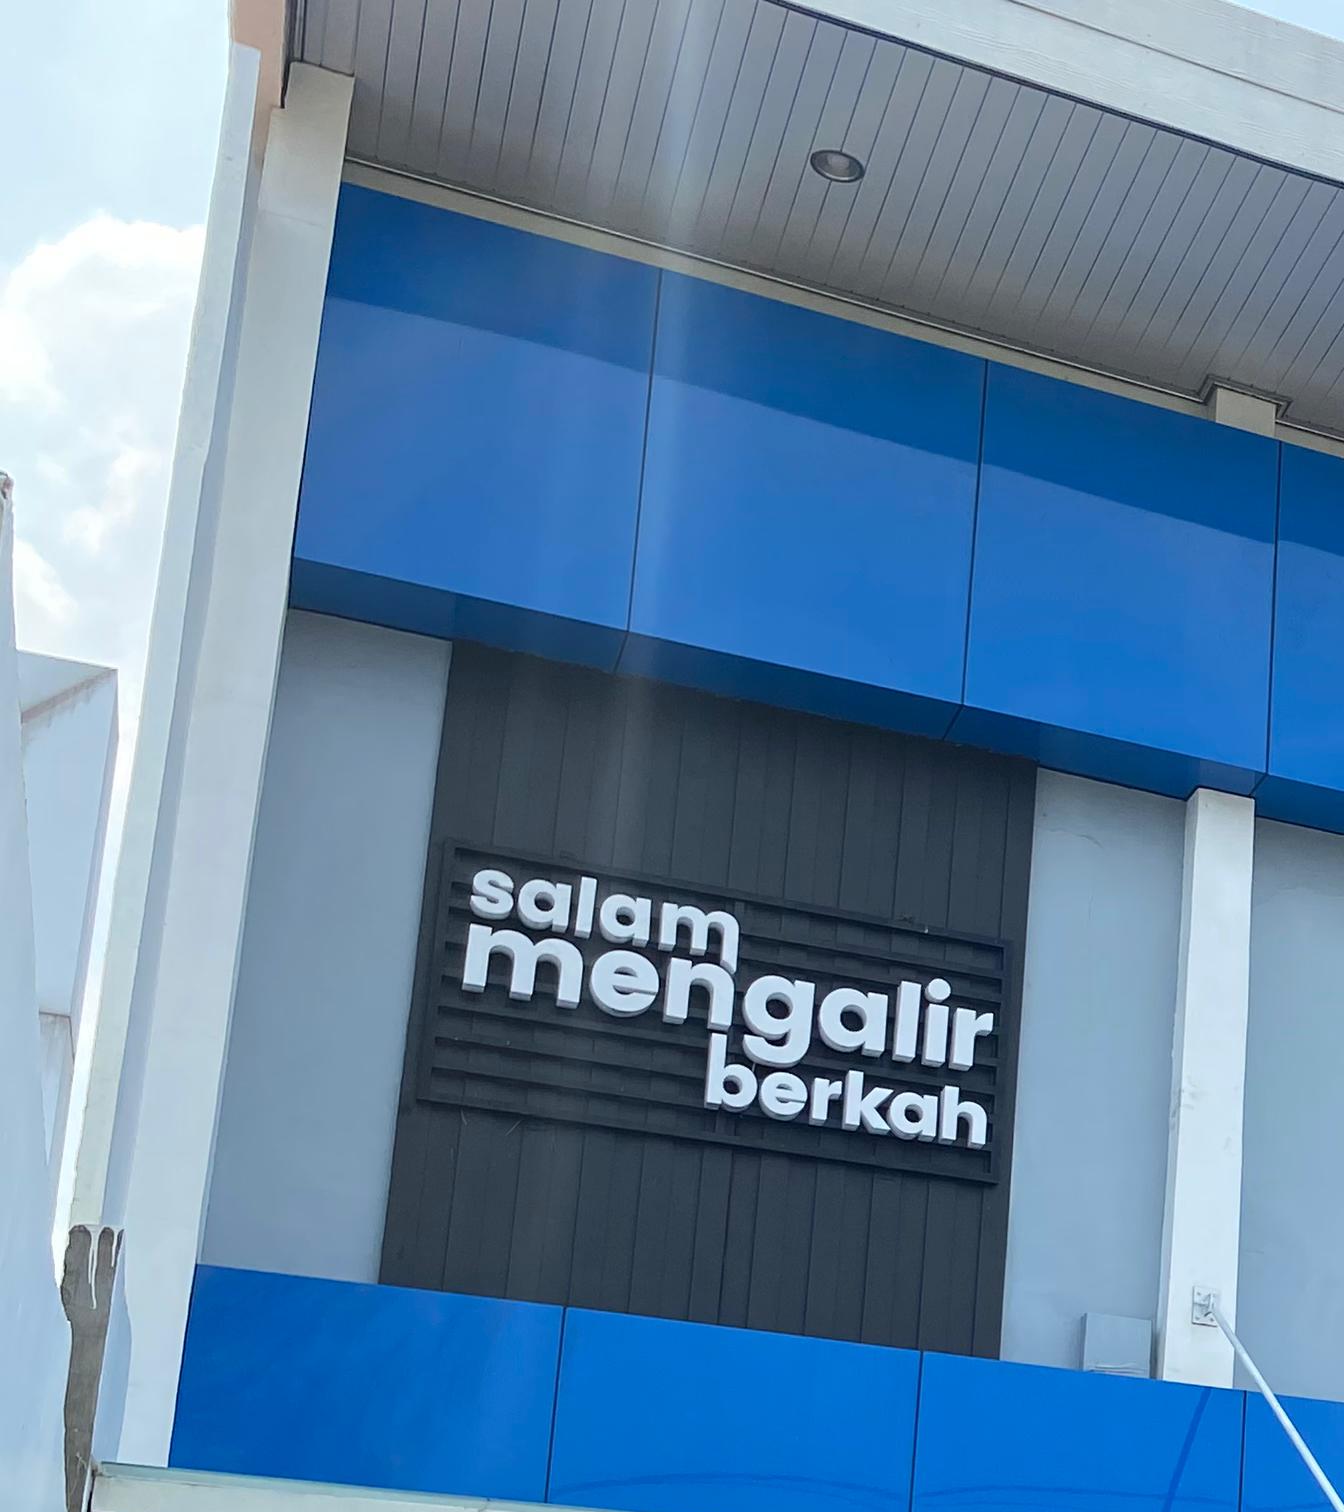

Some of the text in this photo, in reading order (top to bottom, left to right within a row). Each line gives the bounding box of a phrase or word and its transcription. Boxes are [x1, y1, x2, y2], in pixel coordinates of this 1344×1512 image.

[470, 869, 740, 975] salam
[461, 923, 993, 1071] mengalir
[705, 1032, 988, 1149] berkah
